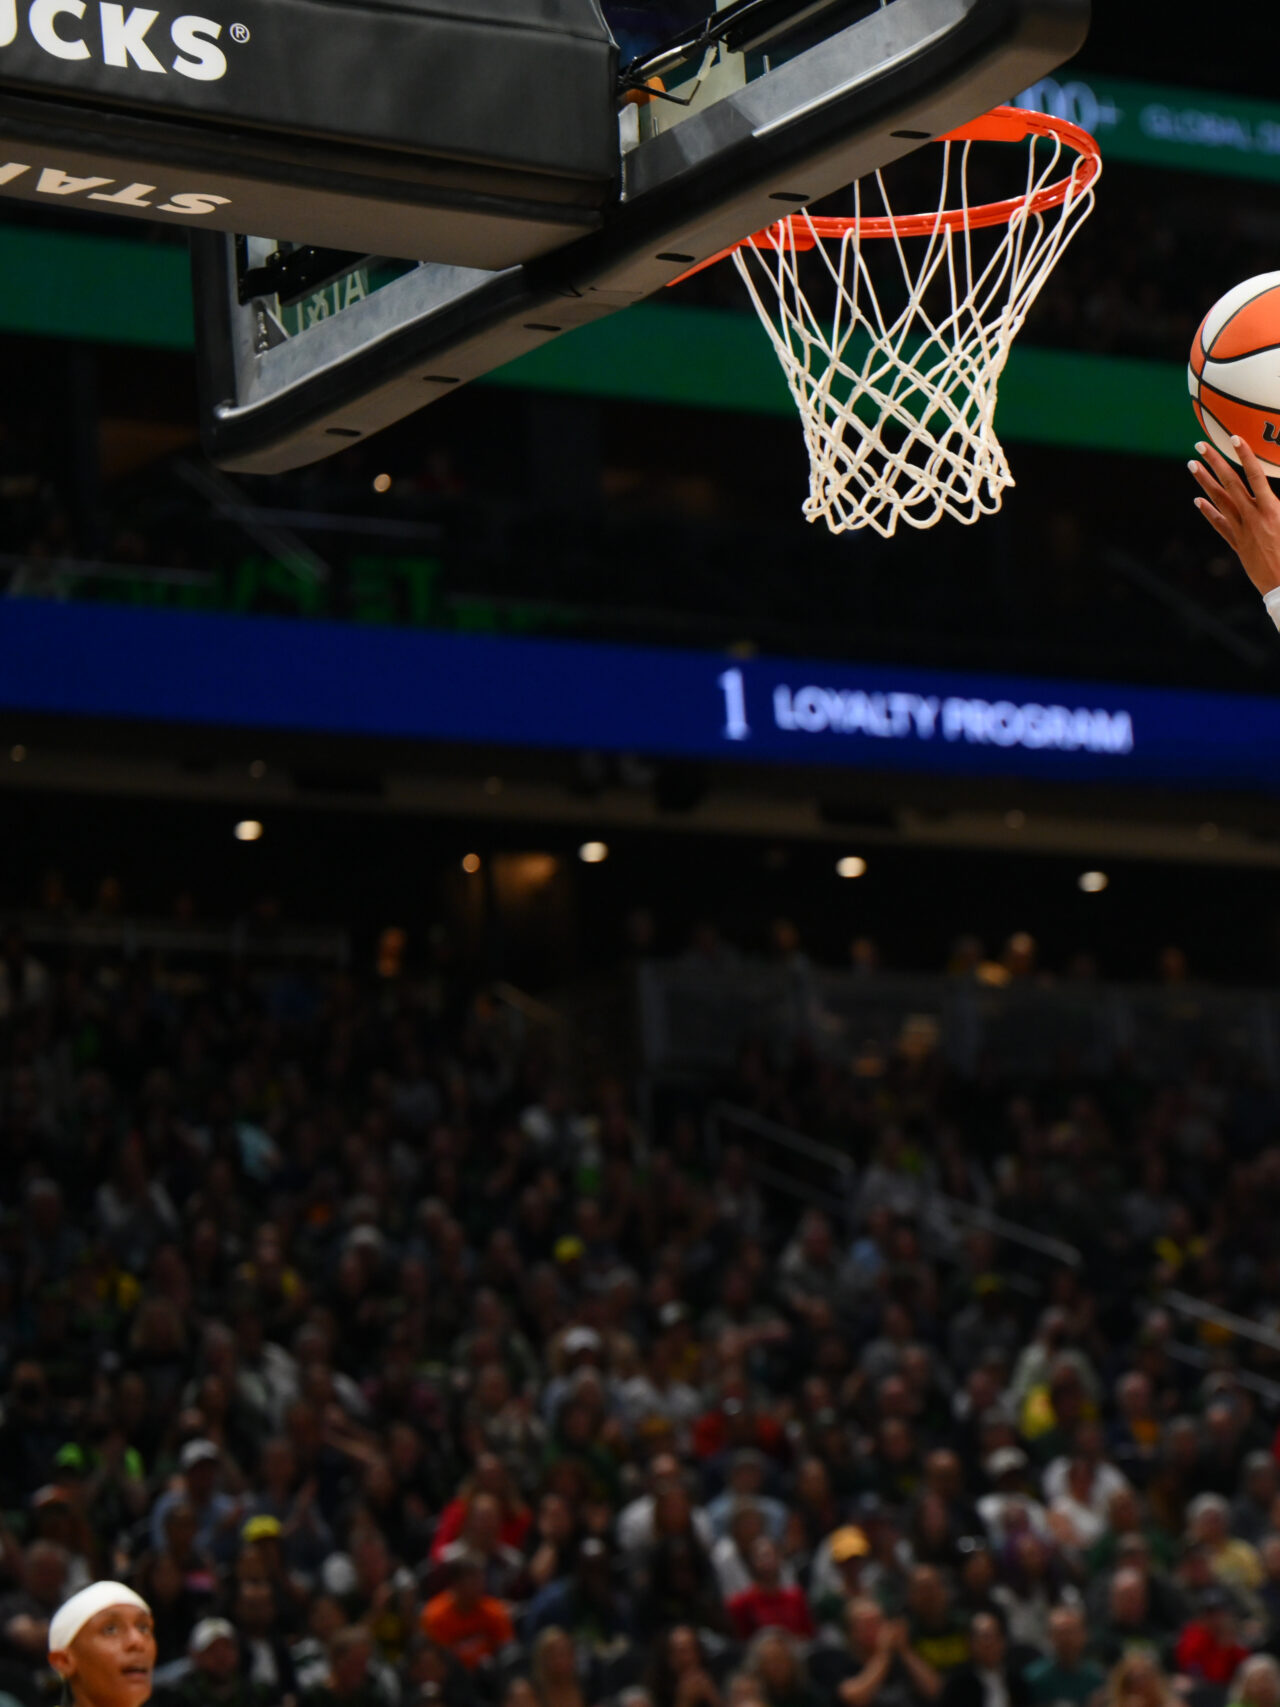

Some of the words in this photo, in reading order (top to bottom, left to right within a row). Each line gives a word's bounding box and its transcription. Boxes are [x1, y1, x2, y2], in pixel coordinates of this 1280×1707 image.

[1140, 104, 1254, 151] GLOBAL
[773, 683, 938, 739] LOYALTY
[942, 696, 1134, 754] PROGRAM
